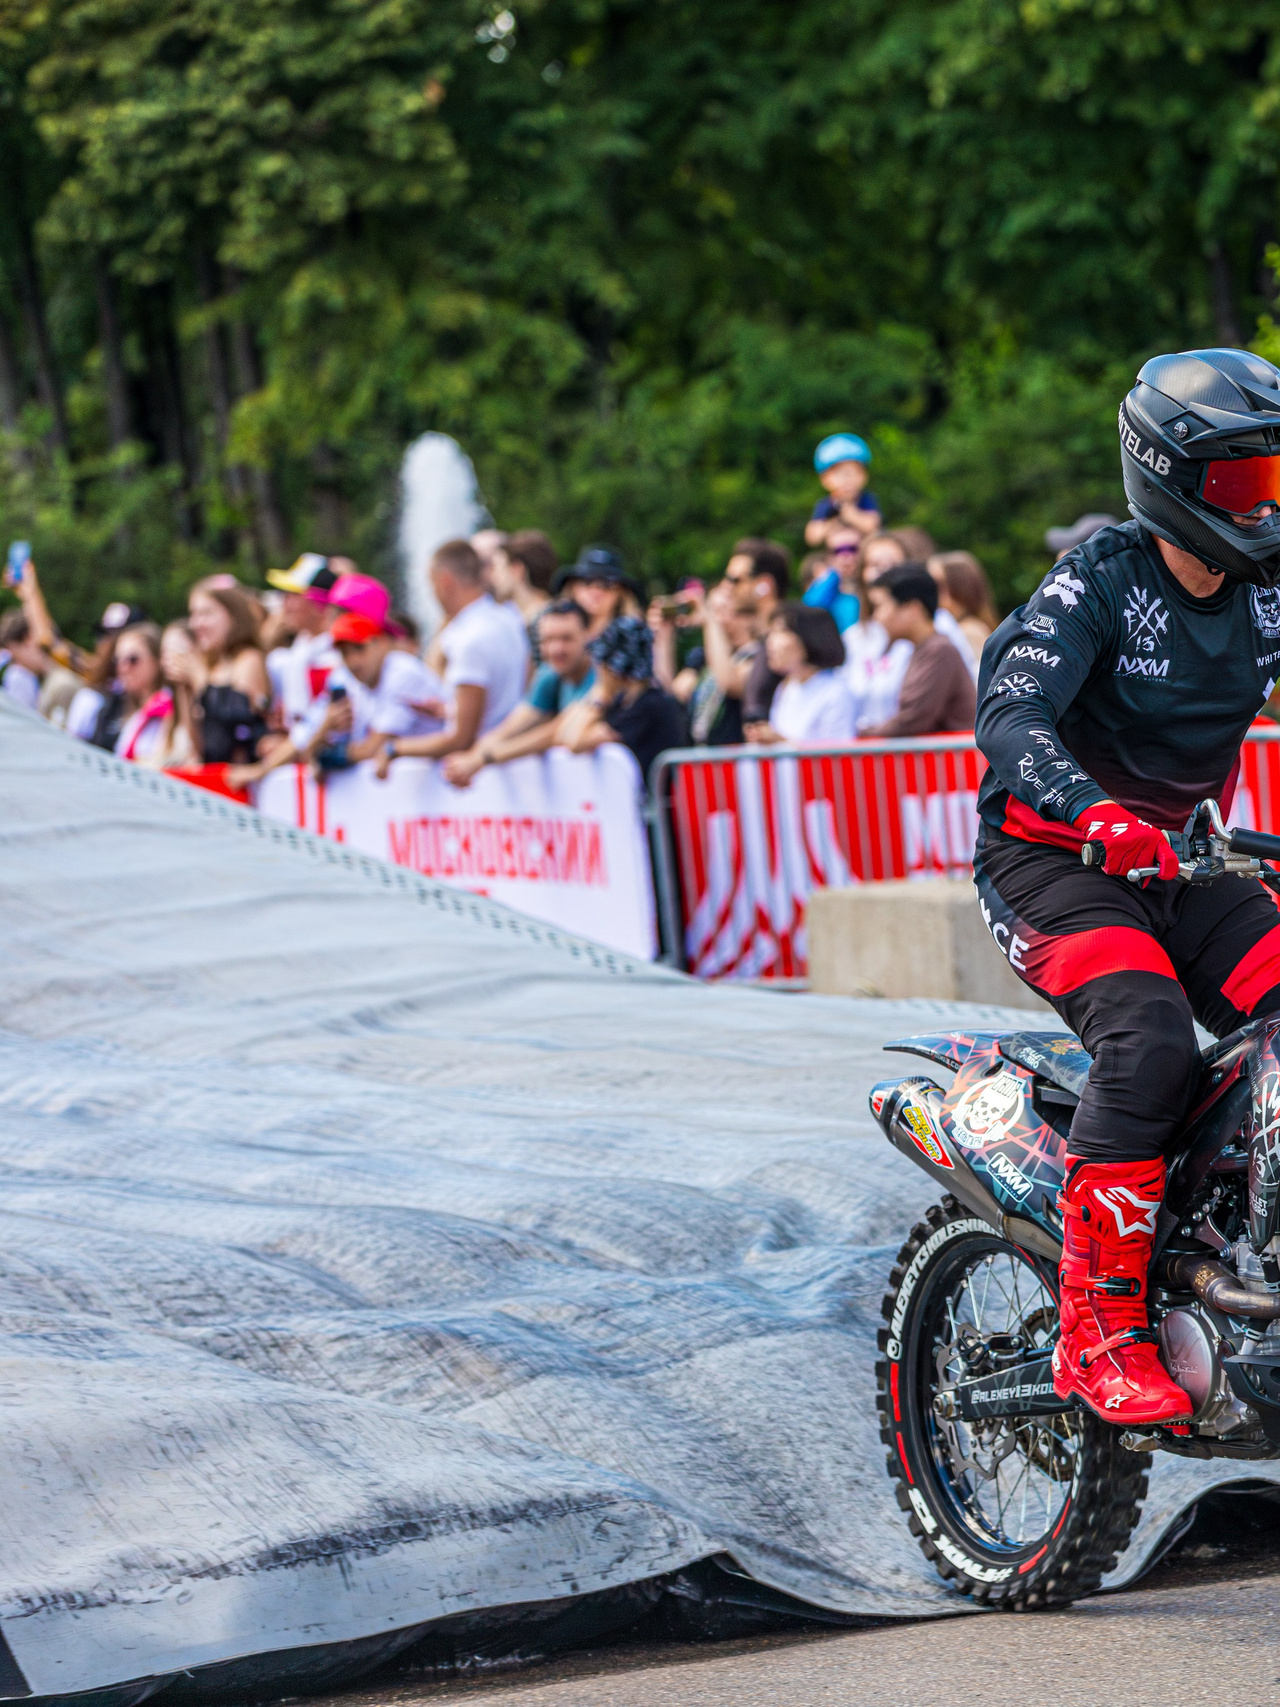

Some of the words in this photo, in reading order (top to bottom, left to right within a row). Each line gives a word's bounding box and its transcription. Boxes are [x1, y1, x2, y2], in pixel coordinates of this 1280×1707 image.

[1006, 645, 1061, 668] NXM
[1116, 654, 1169, 677] NXM
[903, 1107, 940, 1160] CIRCUIT
[911, 1105, 931, 1136] PRO
[991, 1154, 1031, 1196] NXM
